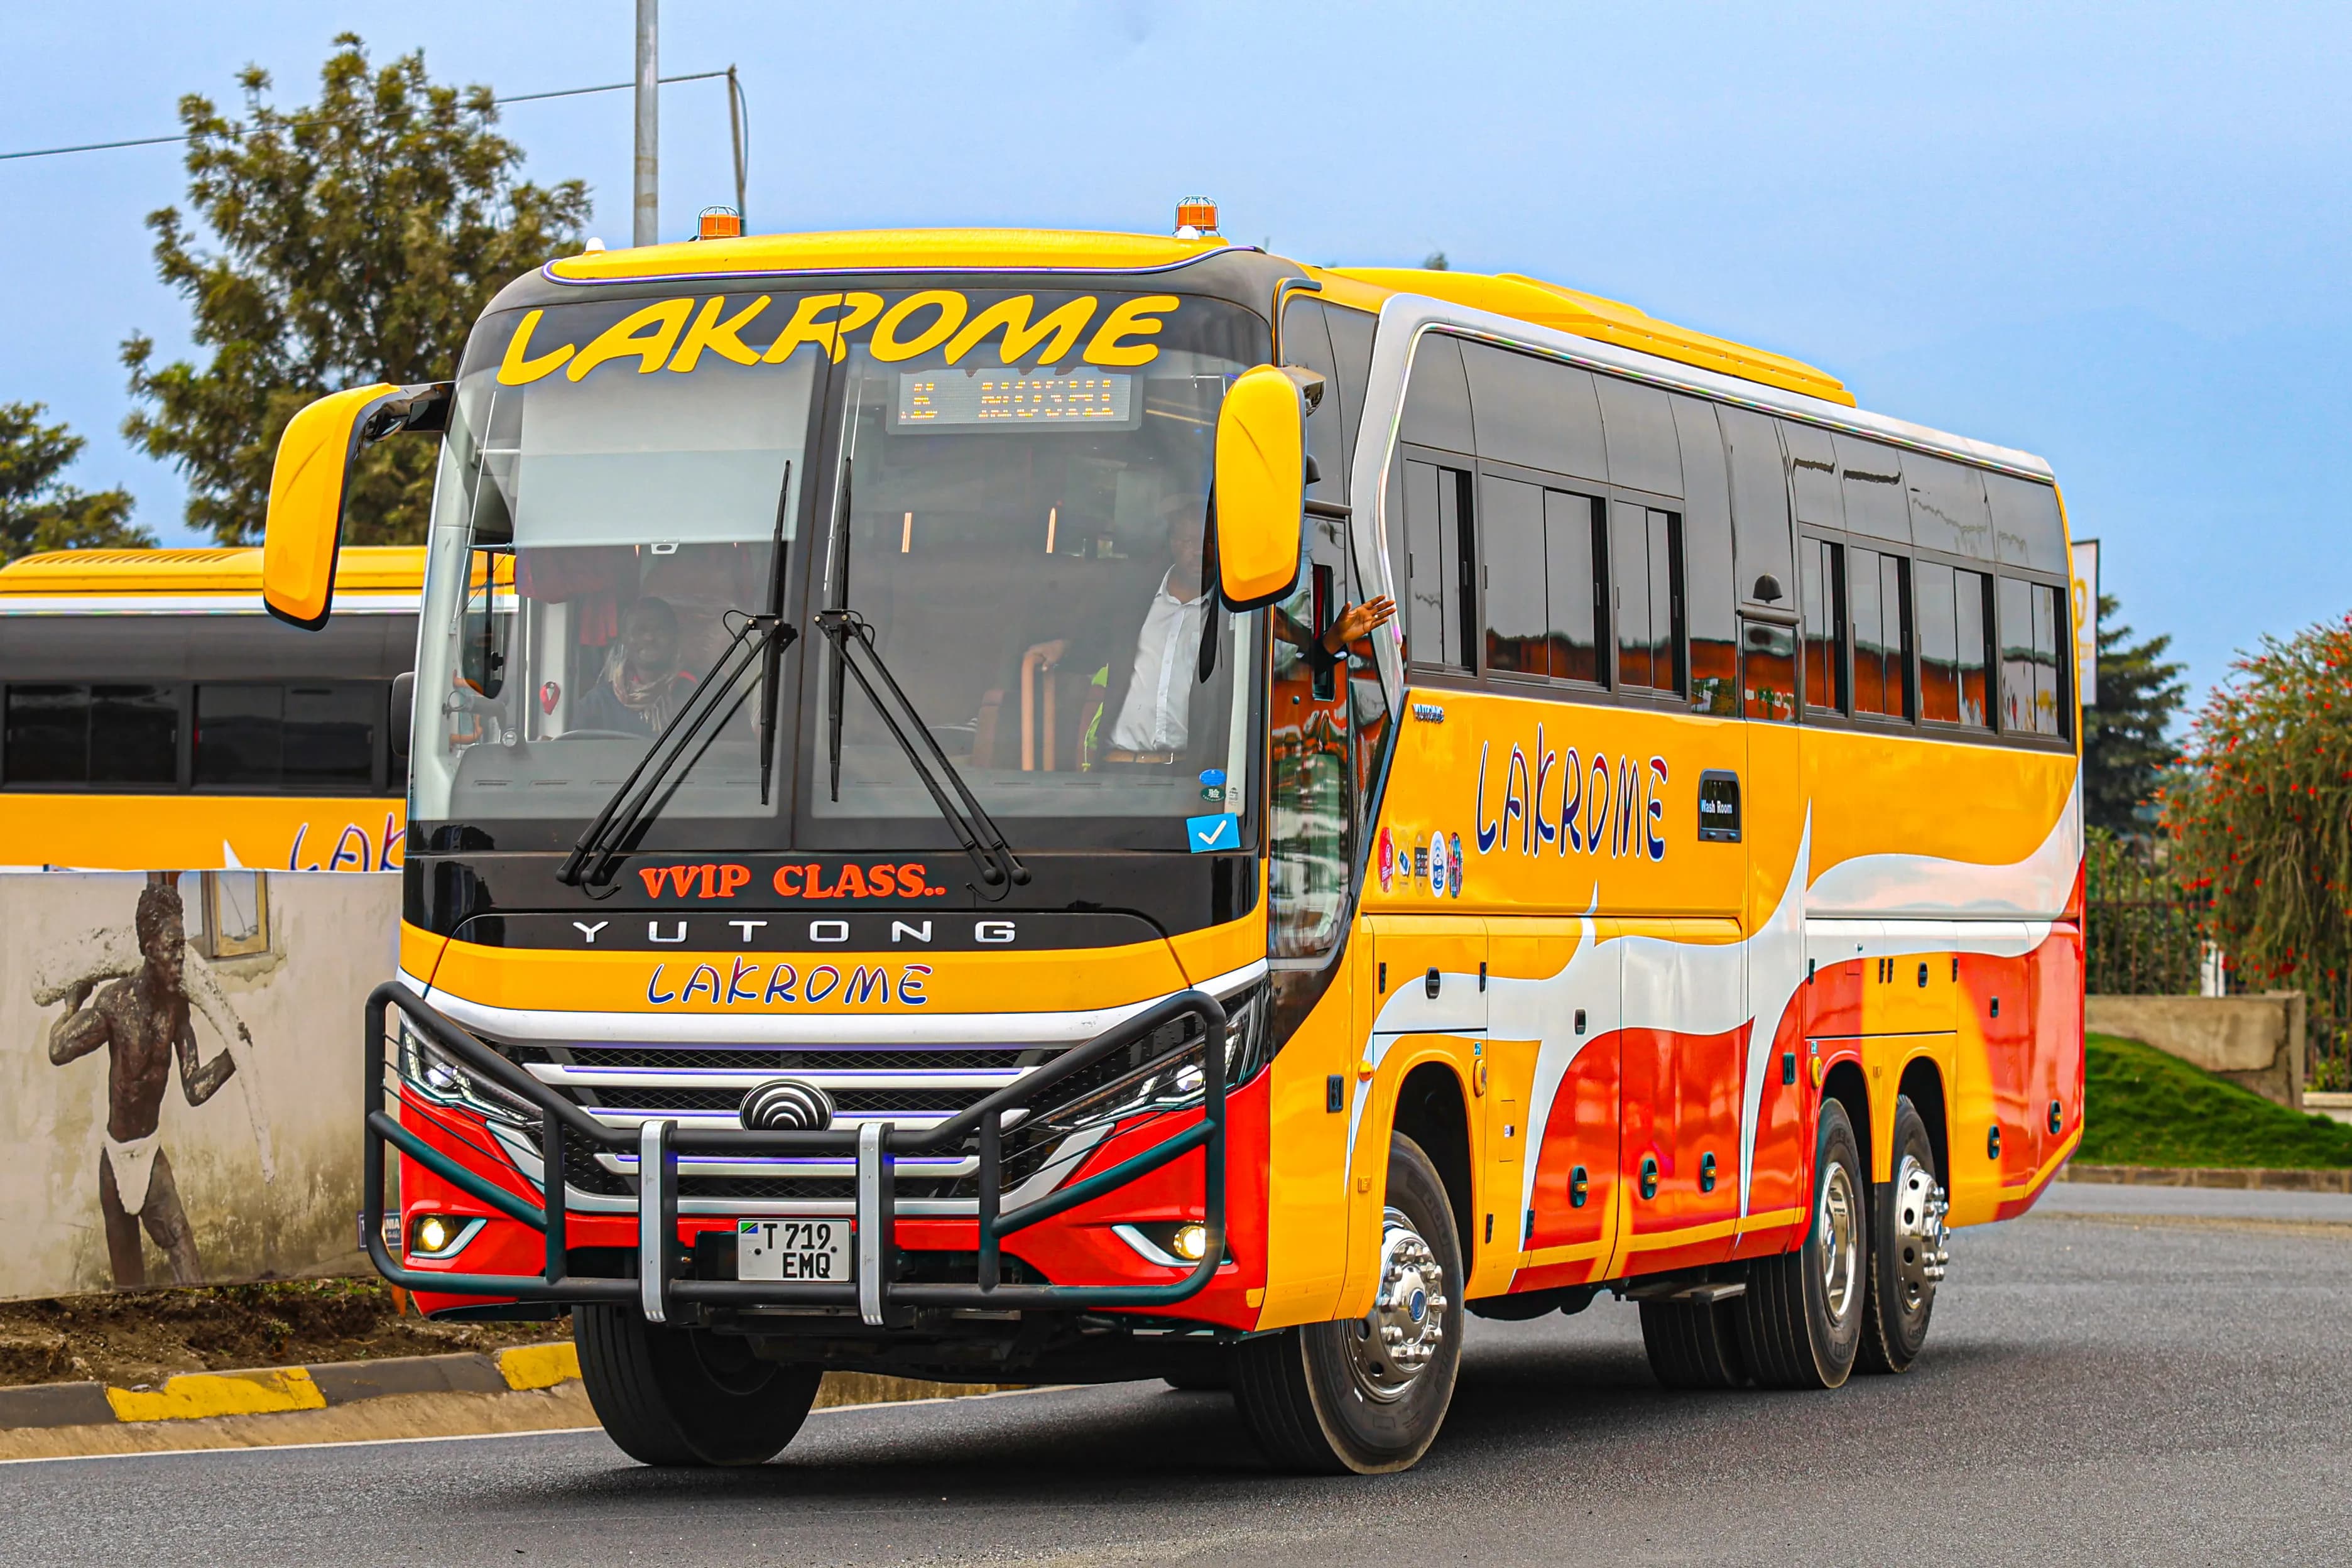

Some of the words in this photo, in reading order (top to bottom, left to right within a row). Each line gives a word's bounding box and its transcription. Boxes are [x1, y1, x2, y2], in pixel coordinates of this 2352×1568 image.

[496, 289, 1180, 386] LAKROME
[1412, 703, 1444, 723] YUTONG
[1474, 721, 1669, 863] LAKROME
[1701, 799, 1716, 814] Wash
[1716, 800, 1733, 814] Room
[638, 864, 751, 900] VVIP
[572, 920, 1017, 944] YUTONG
[646, 956, 934, 1005] LAKROME
[763, 1223, 778, 1250] T
[785, 1223, 832, 1250] 719
[783, 1252, 831, 1279] EMQ
